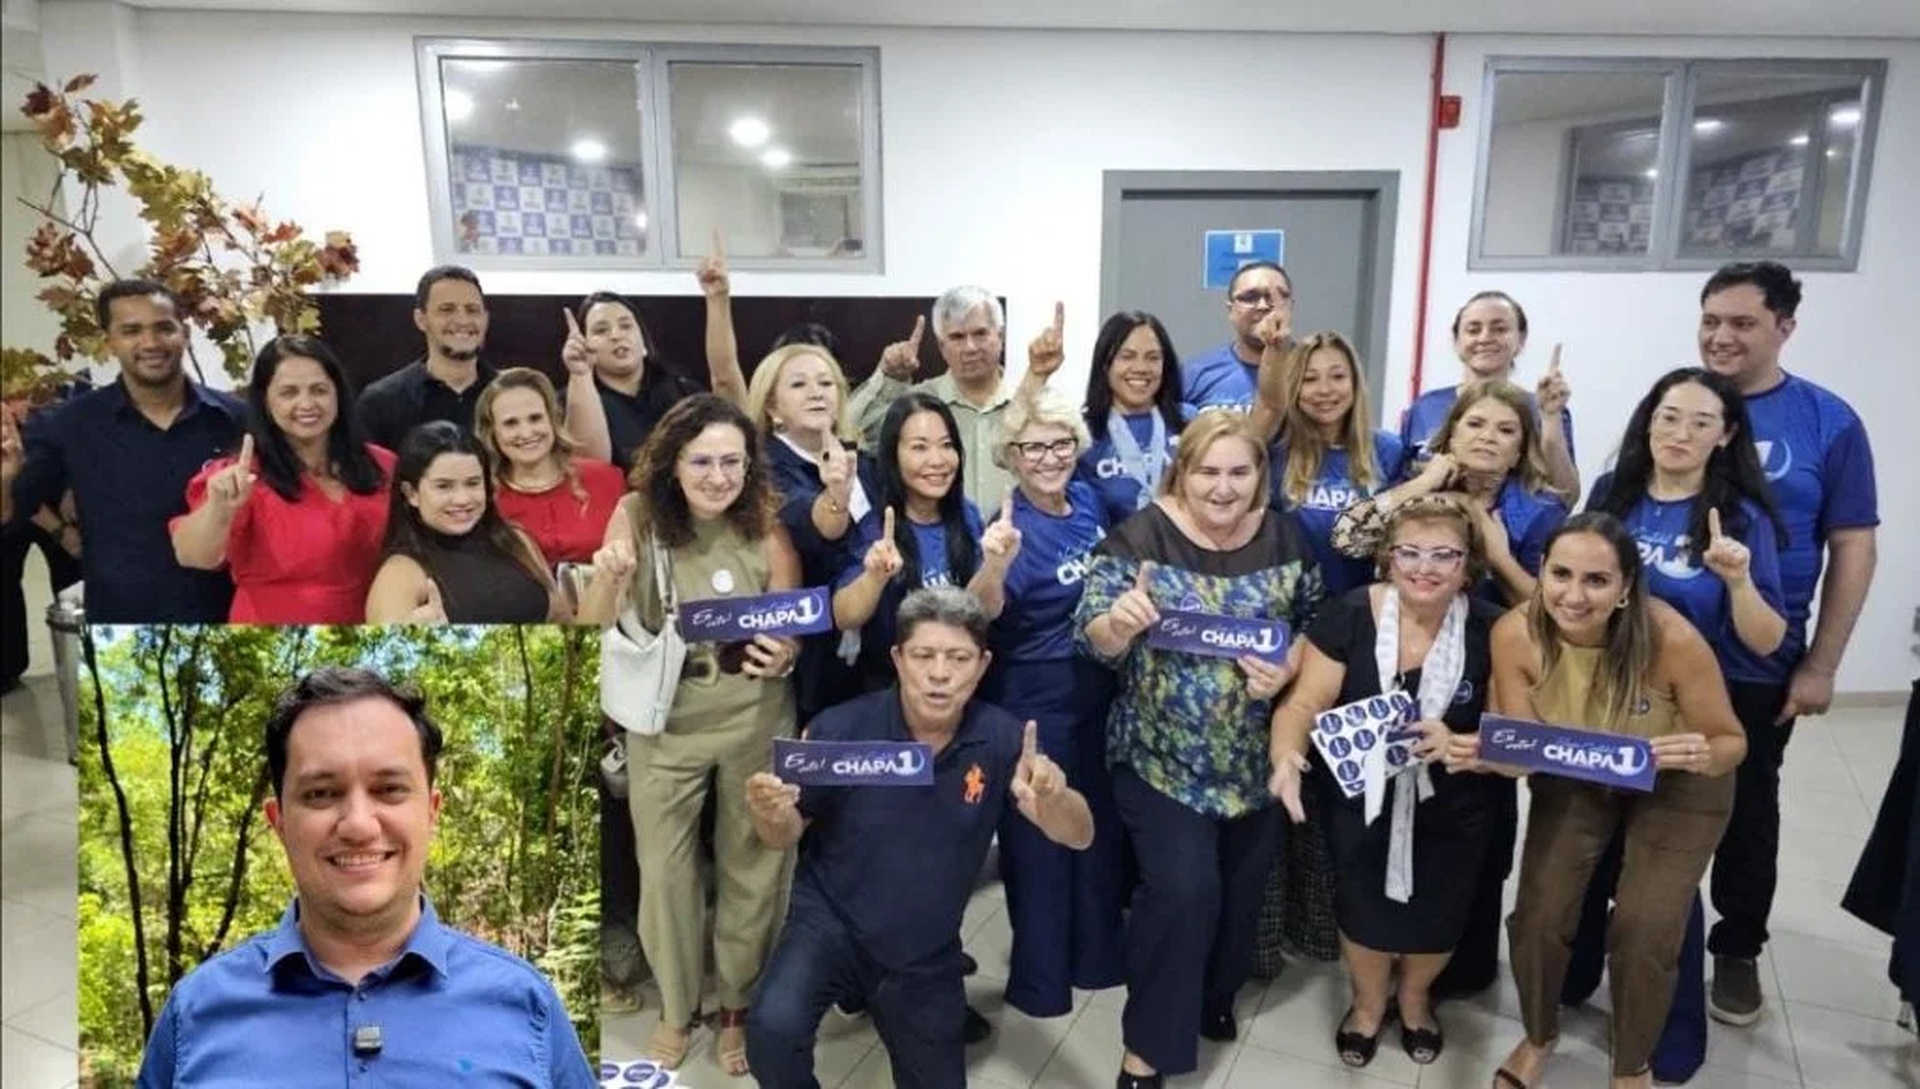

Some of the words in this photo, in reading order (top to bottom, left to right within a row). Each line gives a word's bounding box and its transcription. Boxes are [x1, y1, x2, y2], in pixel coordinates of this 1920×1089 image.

[738, 609, 797, 628] CHAPA
[799, 596, 813, 623] 1
[1201, 629, 1256, 648] CHAPA
[1259, 627, 1273, 651] 1
[832, 758, 896, 775] CHAPA
[898, 750, 914, 774] 1
[1543, 744, 1614, 769] CHAPA
[1617, 746, 1635, 772] 1
